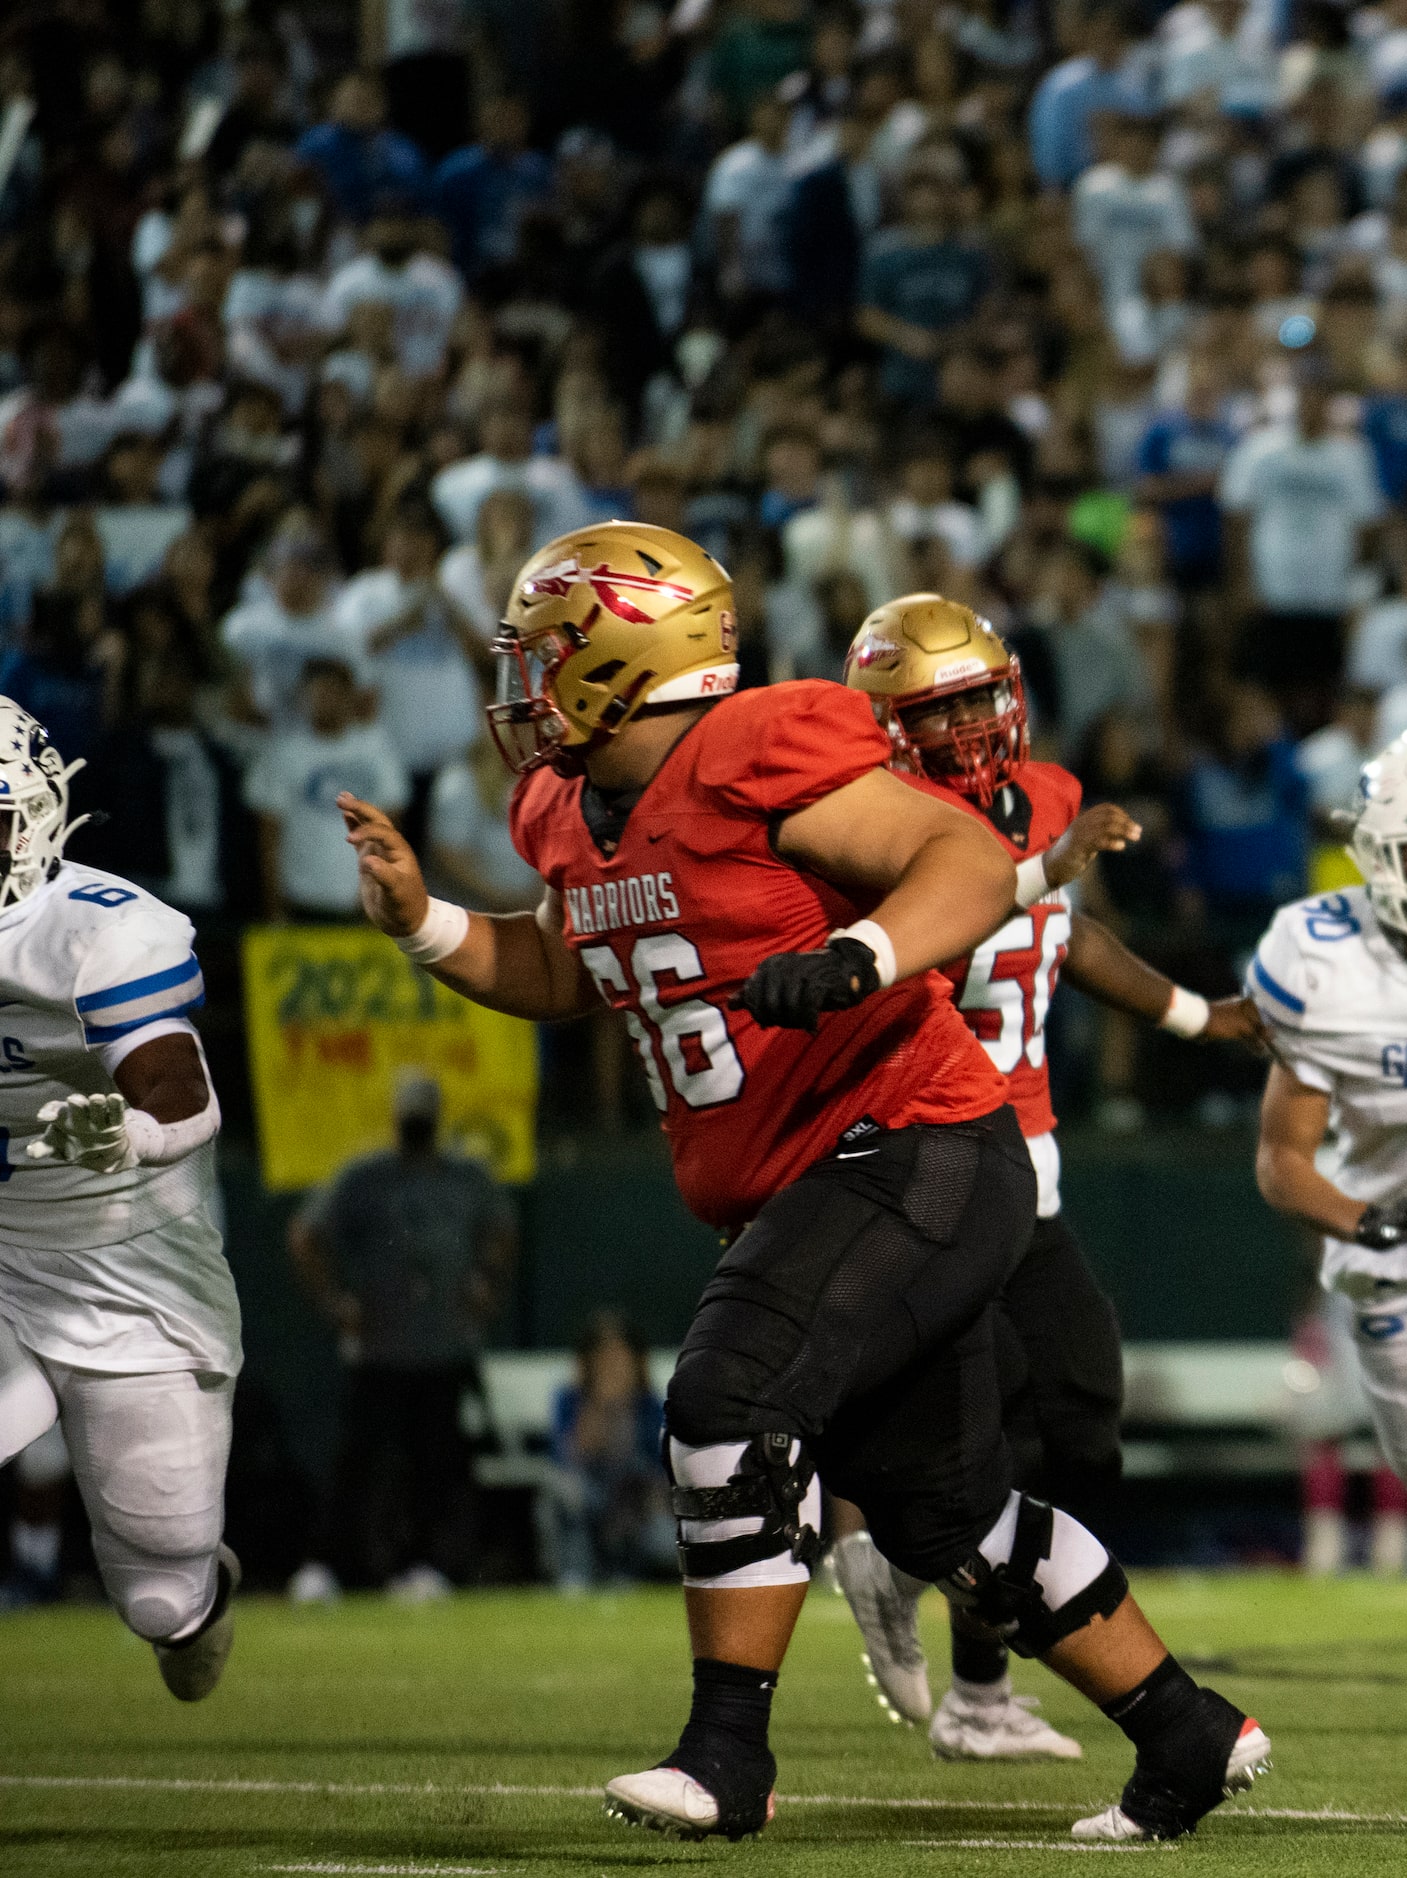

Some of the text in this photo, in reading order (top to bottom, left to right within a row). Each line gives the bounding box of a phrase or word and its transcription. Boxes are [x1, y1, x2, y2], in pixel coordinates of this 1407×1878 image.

[68, 883, 138, 908] 6
[564, 872, 680, 934] WARRIORS
[1303, 894, 1361, 941] 30
